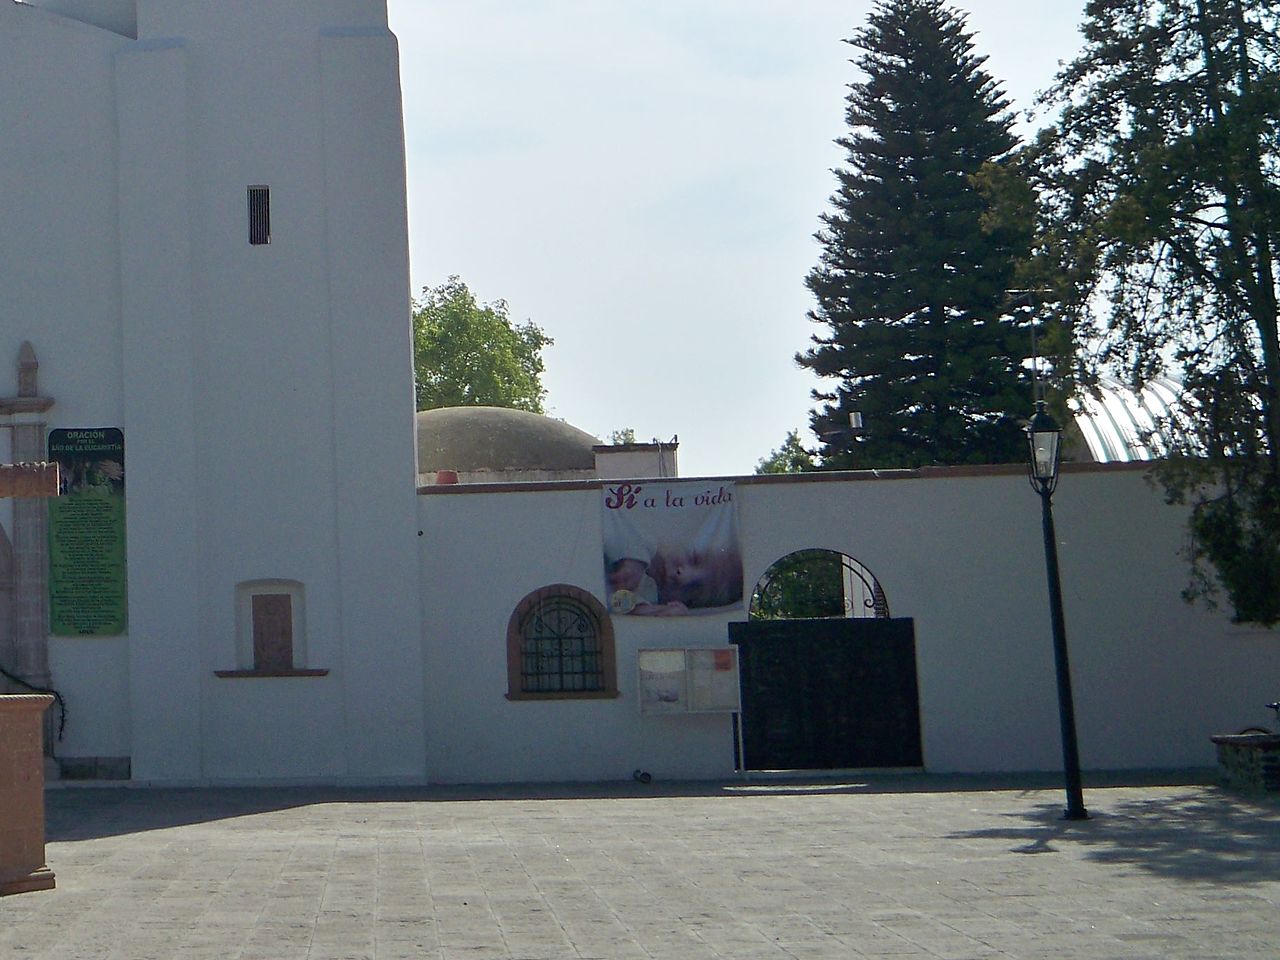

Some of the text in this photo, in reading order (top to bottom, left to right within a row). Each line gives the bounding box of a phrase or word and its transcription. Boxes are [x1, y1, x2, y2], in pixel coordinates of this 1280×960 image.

[67, 430, 105, 438] ORACIÓN
[605, 483, 734, 509] Sí a la vida
